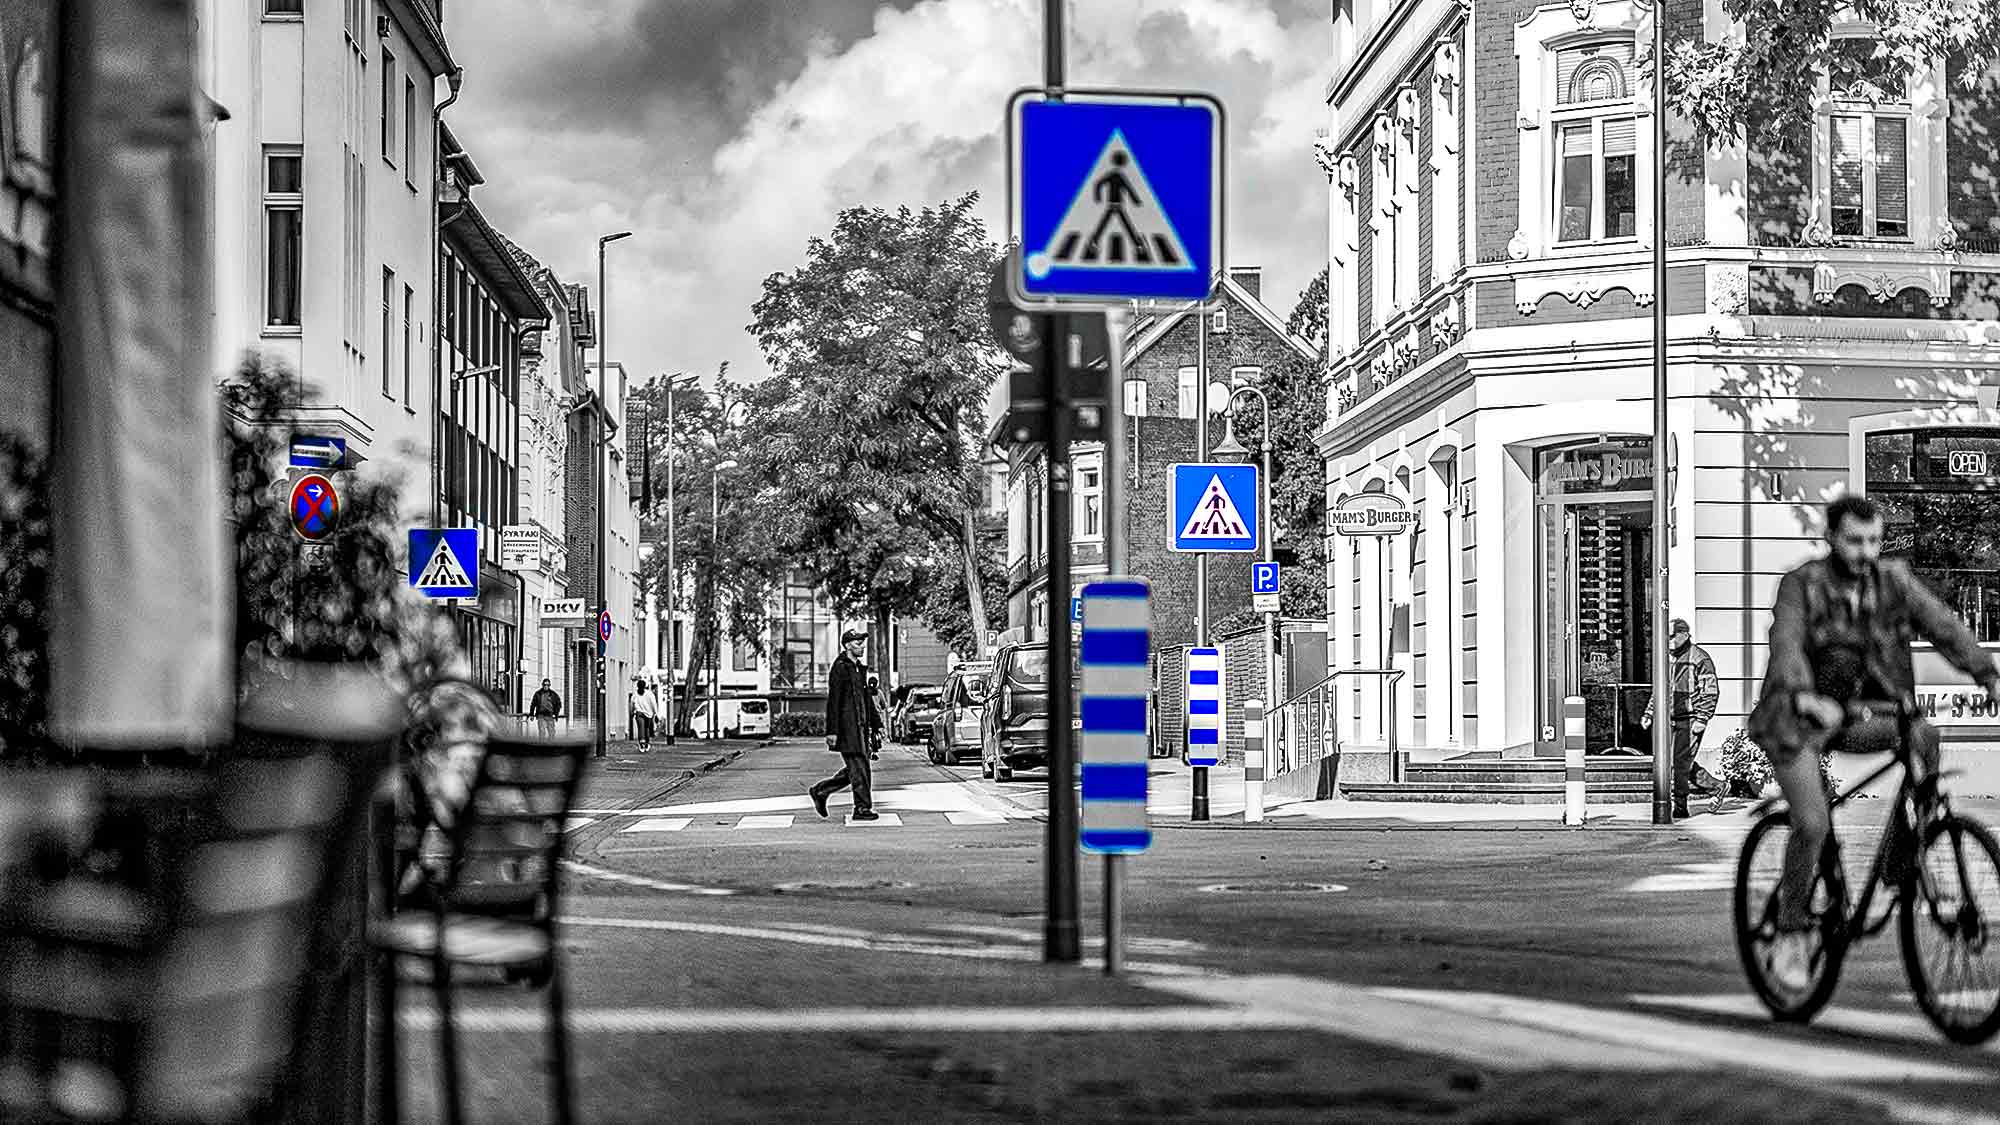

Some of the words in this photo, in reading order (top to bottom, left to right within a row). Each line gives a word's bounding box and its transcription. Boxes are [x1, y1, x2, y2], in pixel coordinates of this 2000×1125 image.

[1601, 453, 1656, 485] BURG
[1952, 453, 1984, 472] OPEN
[1332, 511, 1366, 524] MAM'S
[1366, 508, 1412, 527] BURGER
[503, 530, 539, 538] SYRTAKI
[1258, 566, 1273, 590] P
[543, 603, 580, 614] DKV
